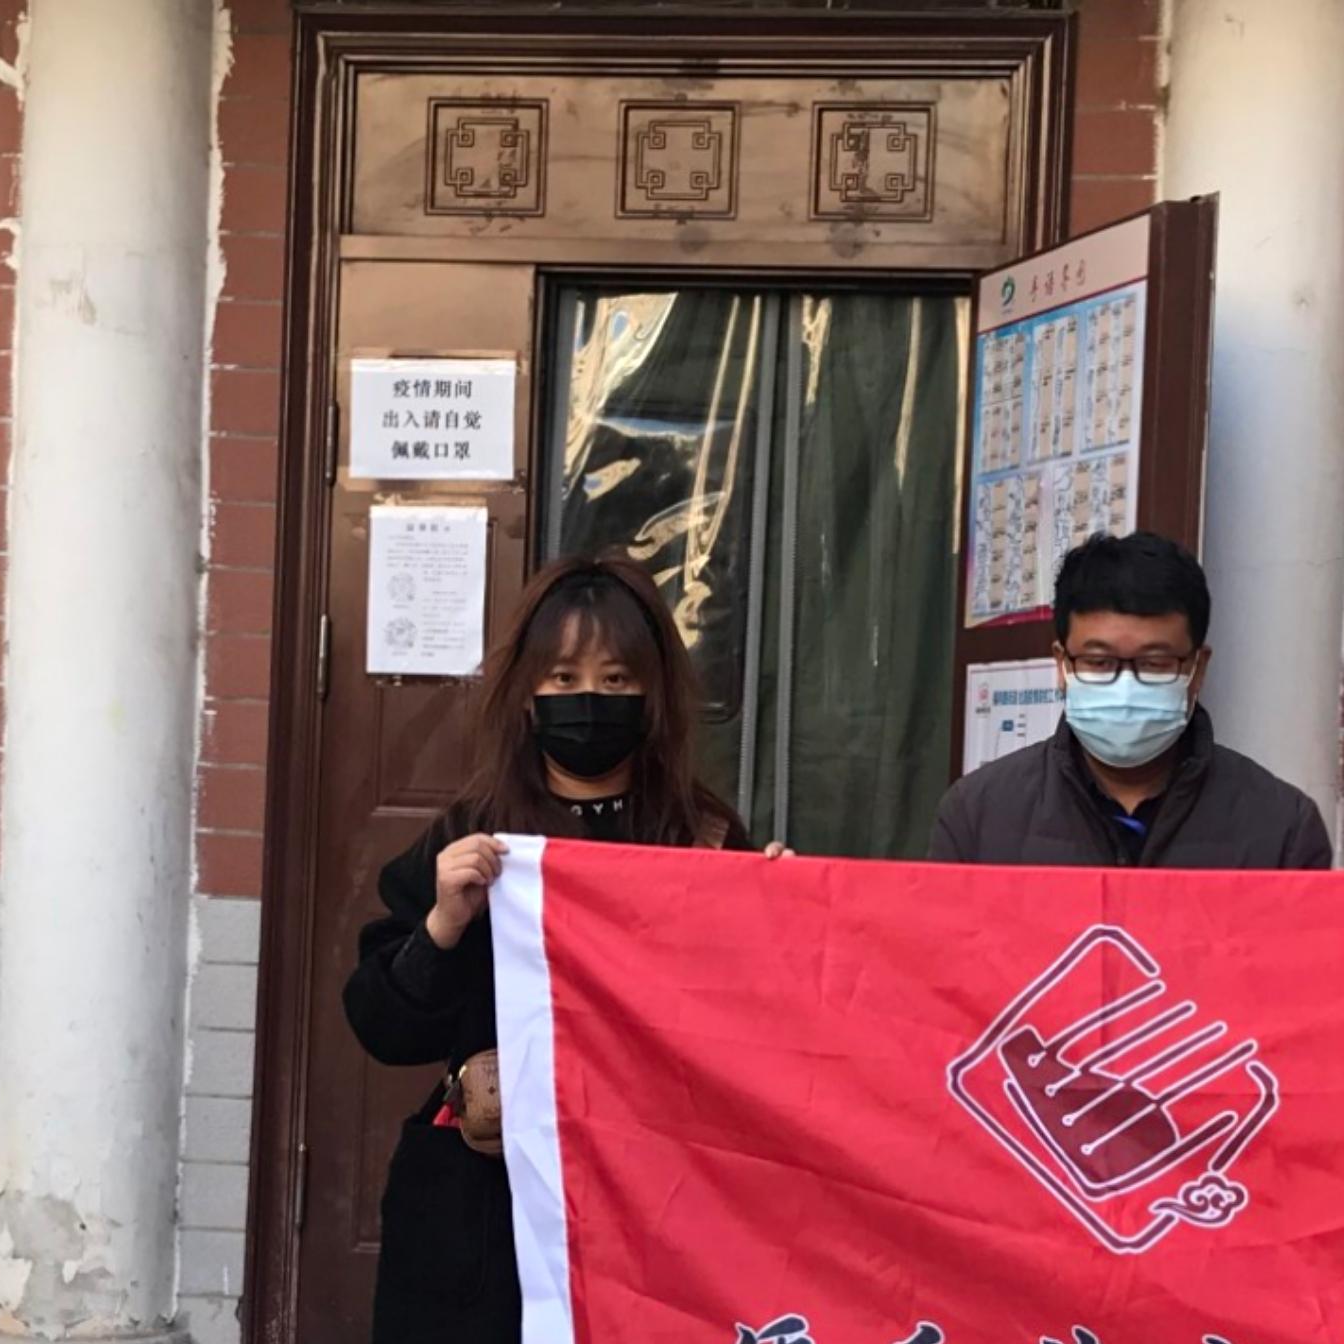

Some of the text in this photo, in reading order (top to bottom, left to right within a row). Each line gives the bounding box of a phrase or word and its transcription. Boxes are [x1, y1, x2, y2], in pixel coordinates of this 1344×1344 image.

[392, 379, 474, 399] 疫情期间
[382, 409, 483, 431] 出入请自觉
[391, 441, 472, 460] 佩戴口罩
